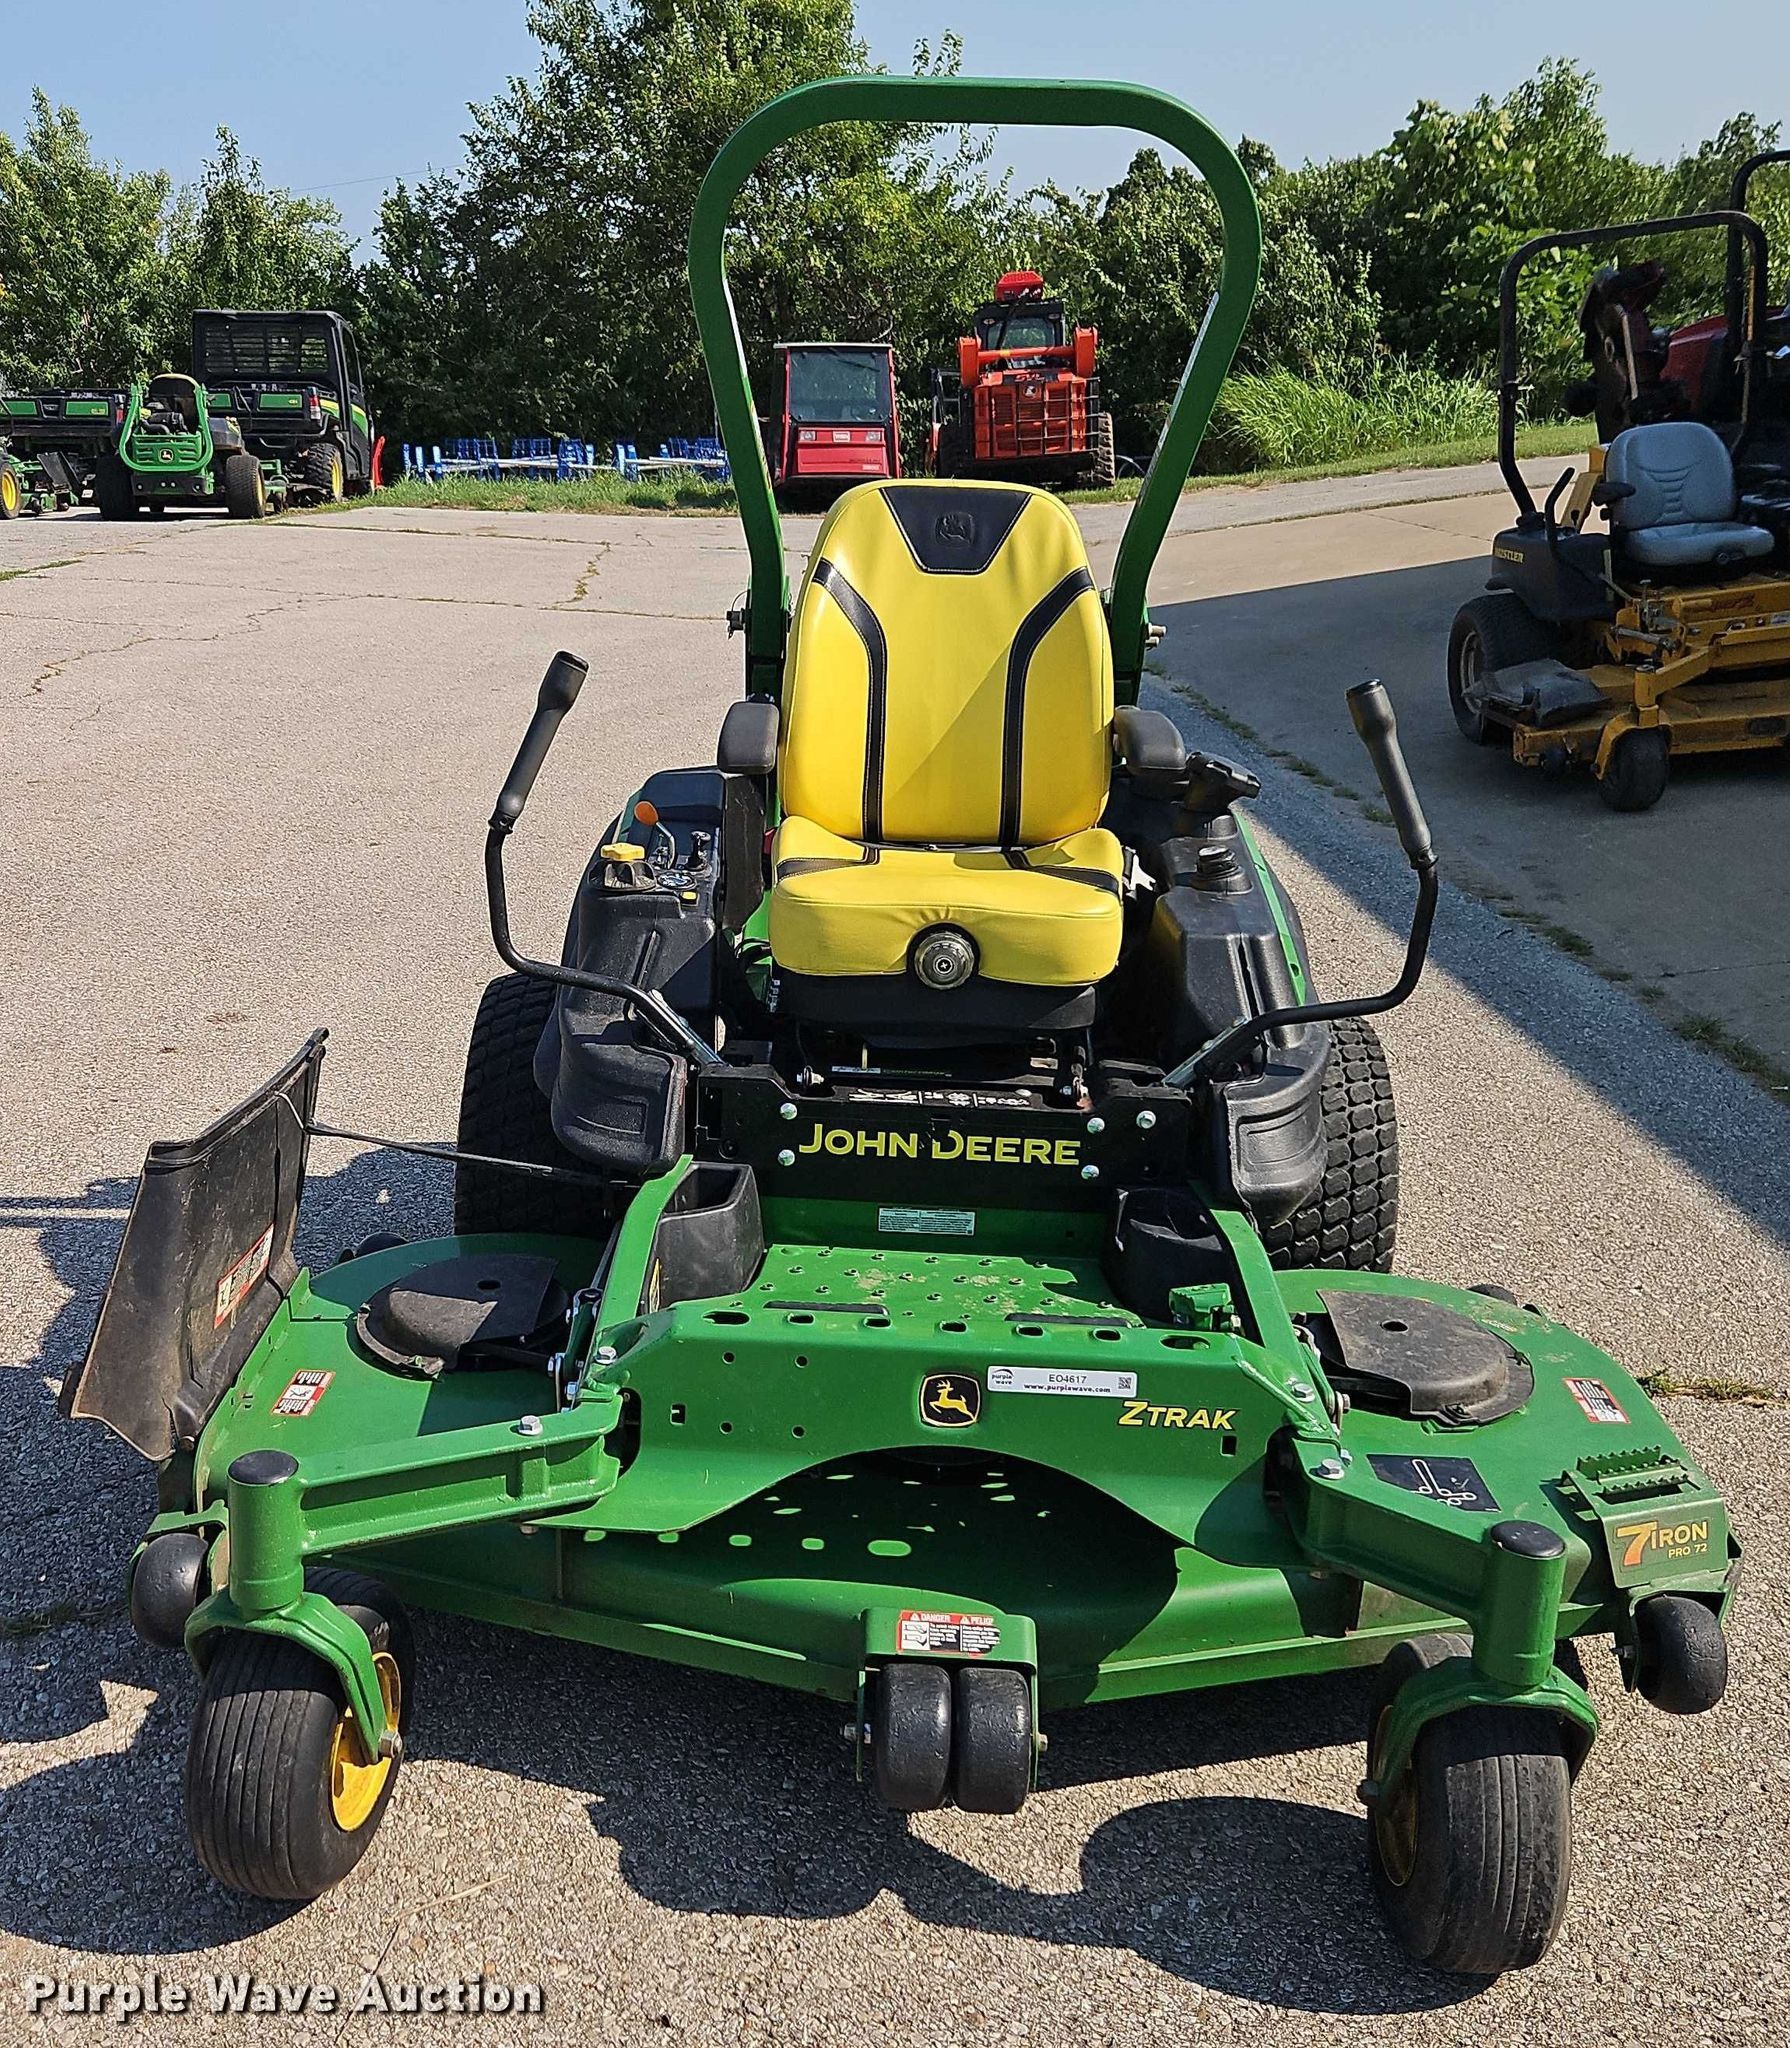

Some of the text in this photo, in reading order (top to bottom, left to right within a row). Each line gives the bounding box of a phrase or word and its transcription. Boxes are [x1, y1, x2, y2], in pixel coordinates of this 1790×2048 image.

[799, 1123, 1081, 1165] JOHN DEERE
[1024, 1383, 1111, 1393] www.purplewave.com
[1118, 1400, 1236, 1430] ZTRAK
[1668, 1543, 1708, 1559] PRO 72
[920, 1613, 951, 1623] DANGER
